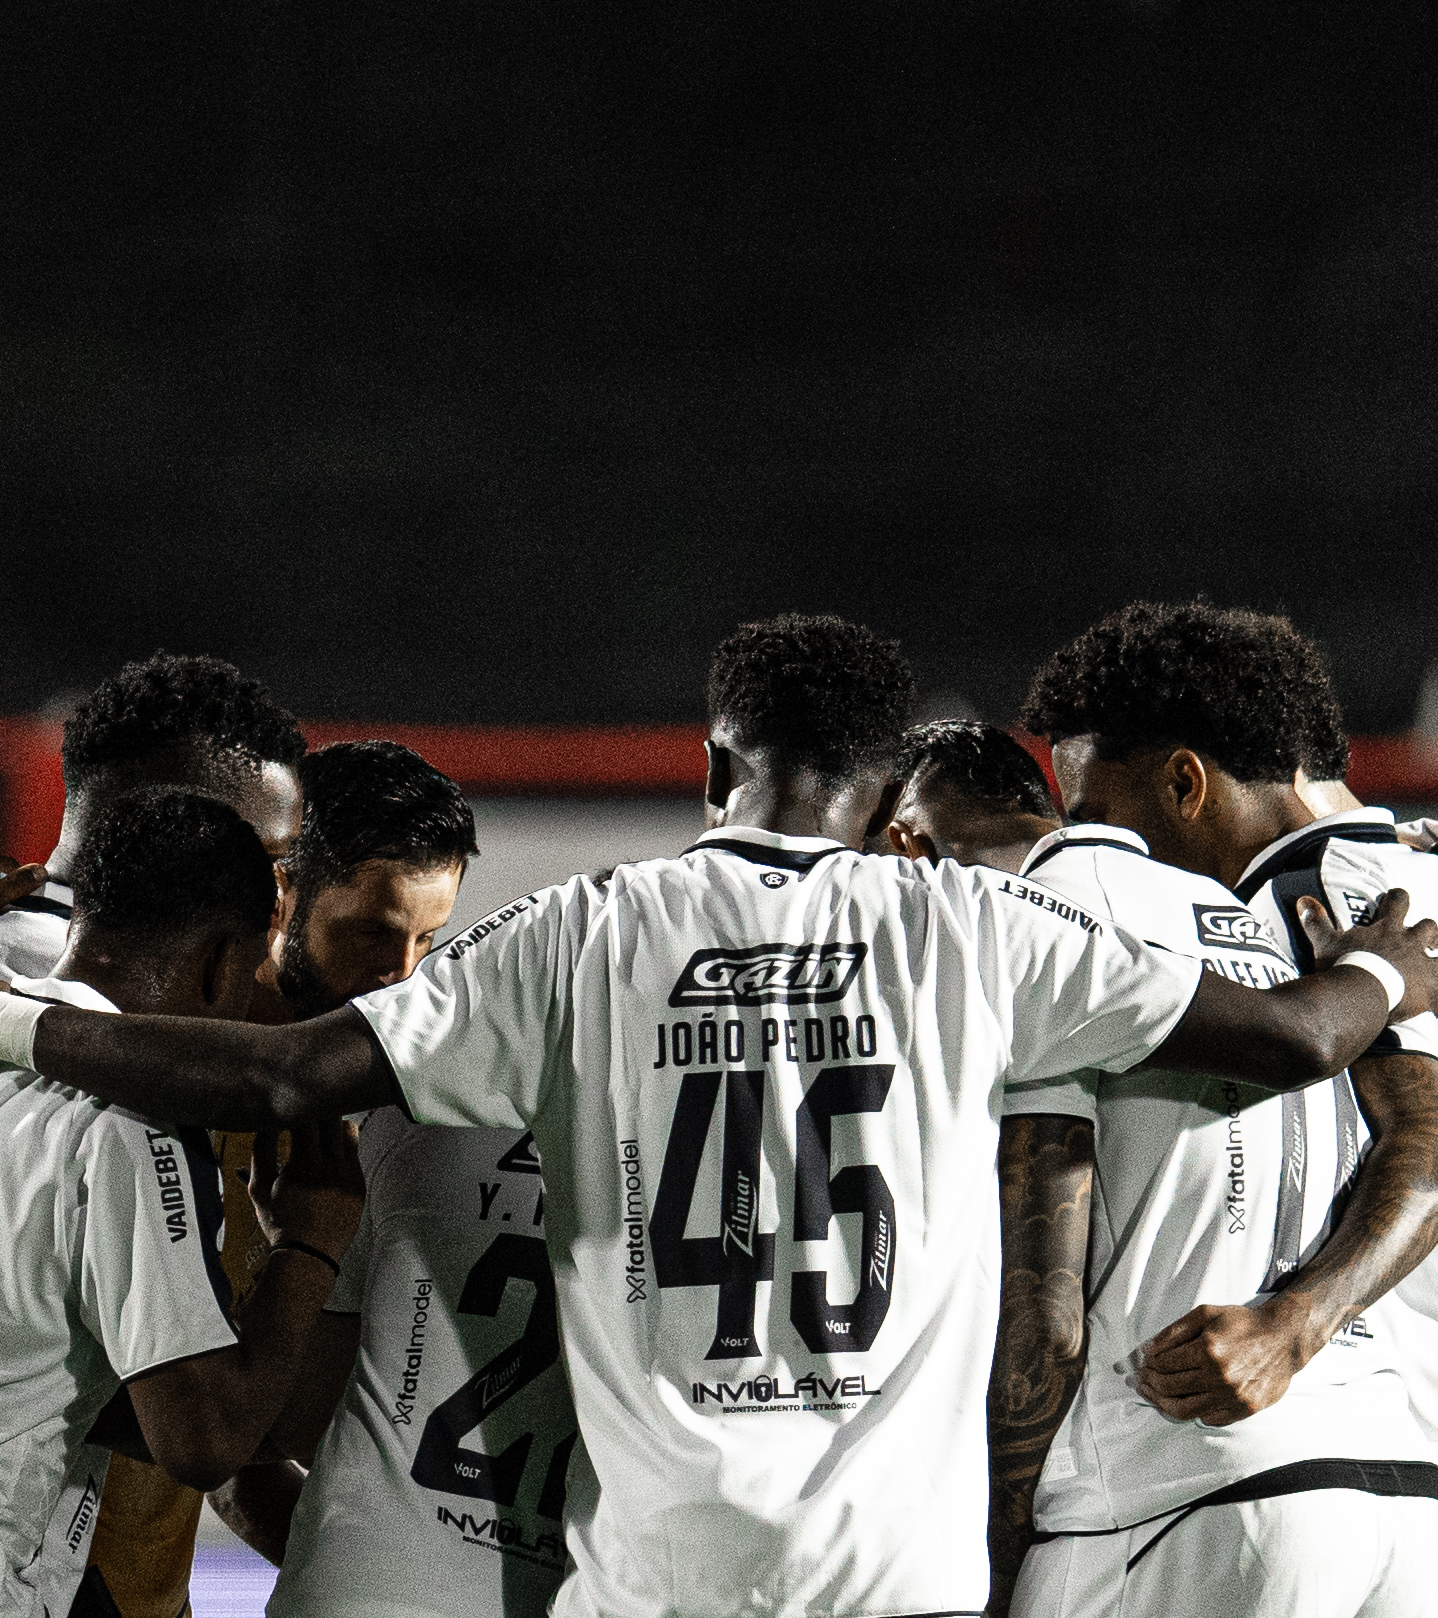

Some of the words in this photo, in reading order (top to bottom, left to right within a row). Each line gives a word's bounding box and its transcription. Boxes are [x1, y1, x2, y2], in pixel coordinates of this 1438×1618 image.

[445, 895, 539, 960] VAIDEBET
[653, 1012, 746, 1069] JOÃO
[762, 1013, 877, 1063] PEDRO
[144, 1129, 188, 1244] VAIDEBET
[622, 1139, 645, 1273] fatalmodel
[649, 1064, 895, 1360] 45
[400, 1279, 433, 1402] fatalmodel
[720, 1338, 749, 1348] VOLT
[826, 1319, 851, 1334] VOLT
[692, 1372, 881, 1405] INVIOLÁVEL
